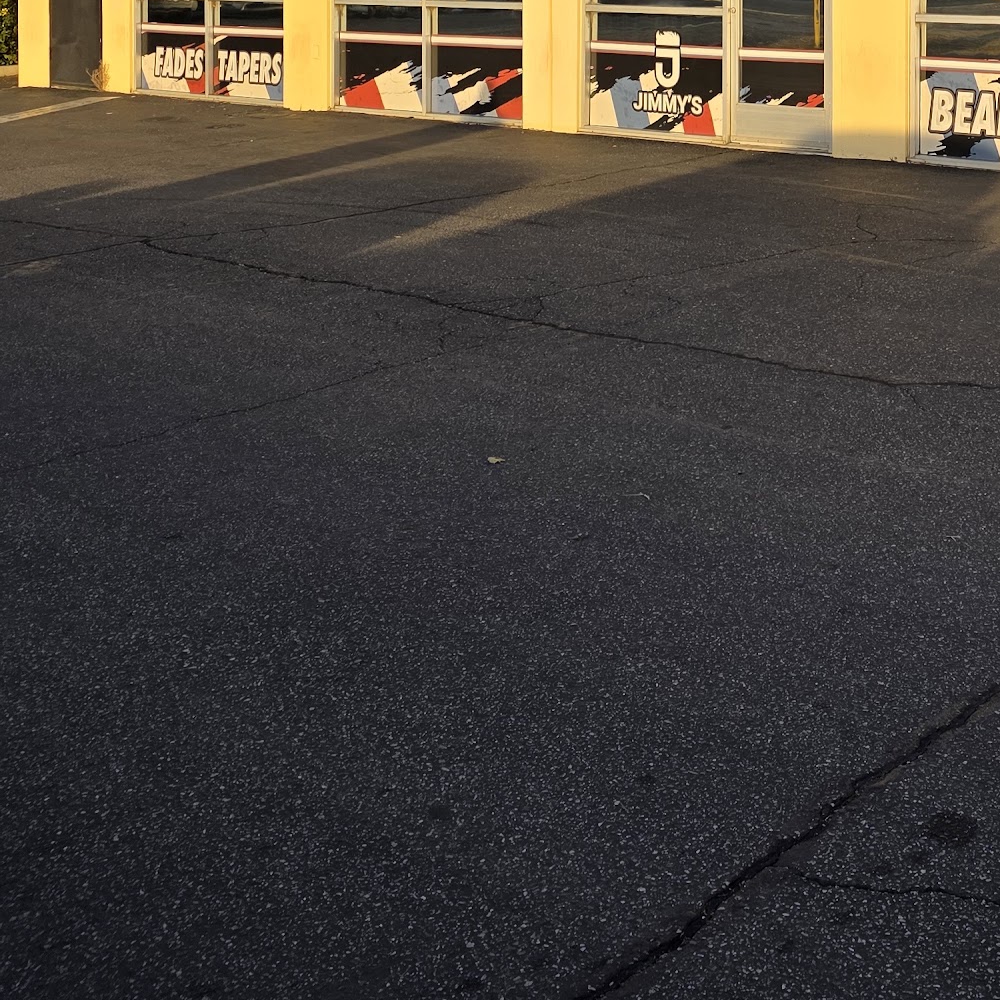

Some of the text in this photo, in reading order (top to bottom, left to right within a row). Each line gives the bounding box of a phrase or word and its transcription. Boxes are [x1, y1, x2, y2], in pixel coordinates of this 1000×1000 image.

[154, 45, 206, 80] FADES
[217, 49, 282, 85] TAPERS
[632, 90, 703, 116] JIMMY'S
